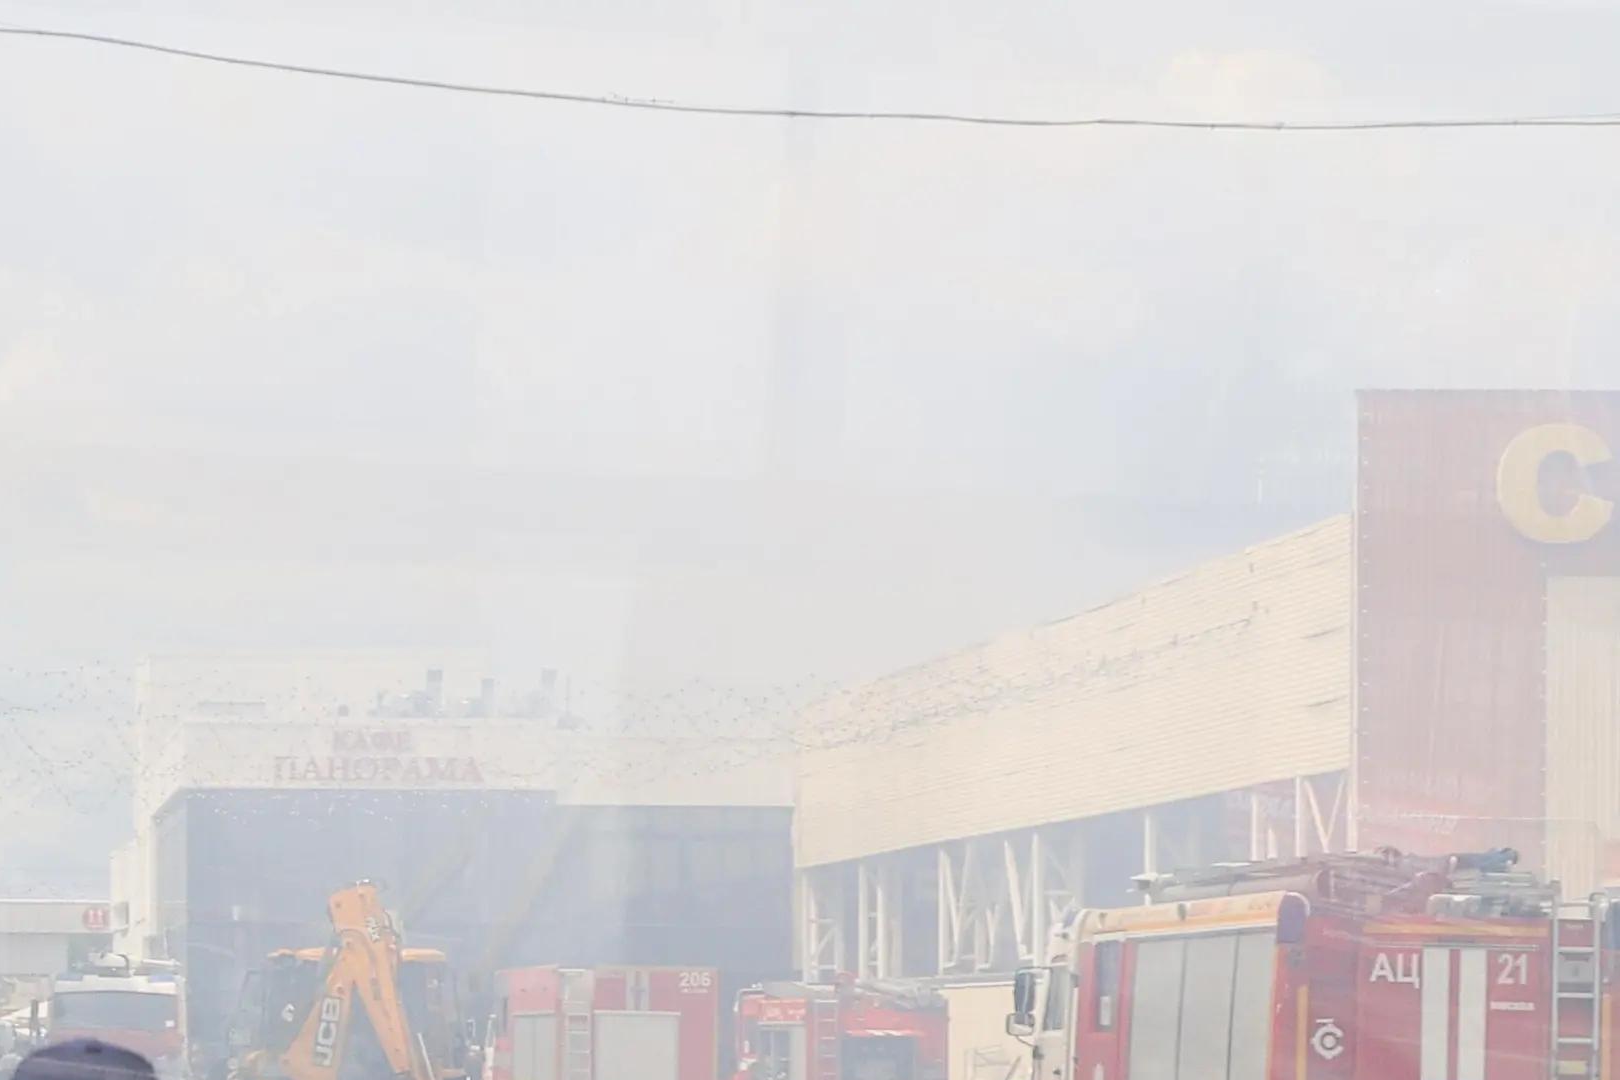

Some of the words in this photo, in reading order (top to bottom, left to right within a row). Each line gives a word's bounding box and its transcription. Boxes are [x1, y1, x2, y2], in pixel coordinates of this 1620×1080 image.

[333, 729, 412, 751] КАФЕ
[274, 755, 485, 783] ПАНОРАМА
[679, 971, 712, 987] 206
[1370, 953, 1421, 989] АЦ
[1497, 953, 1529, 985] 21
[313, 997, 342, 1067] JCB
